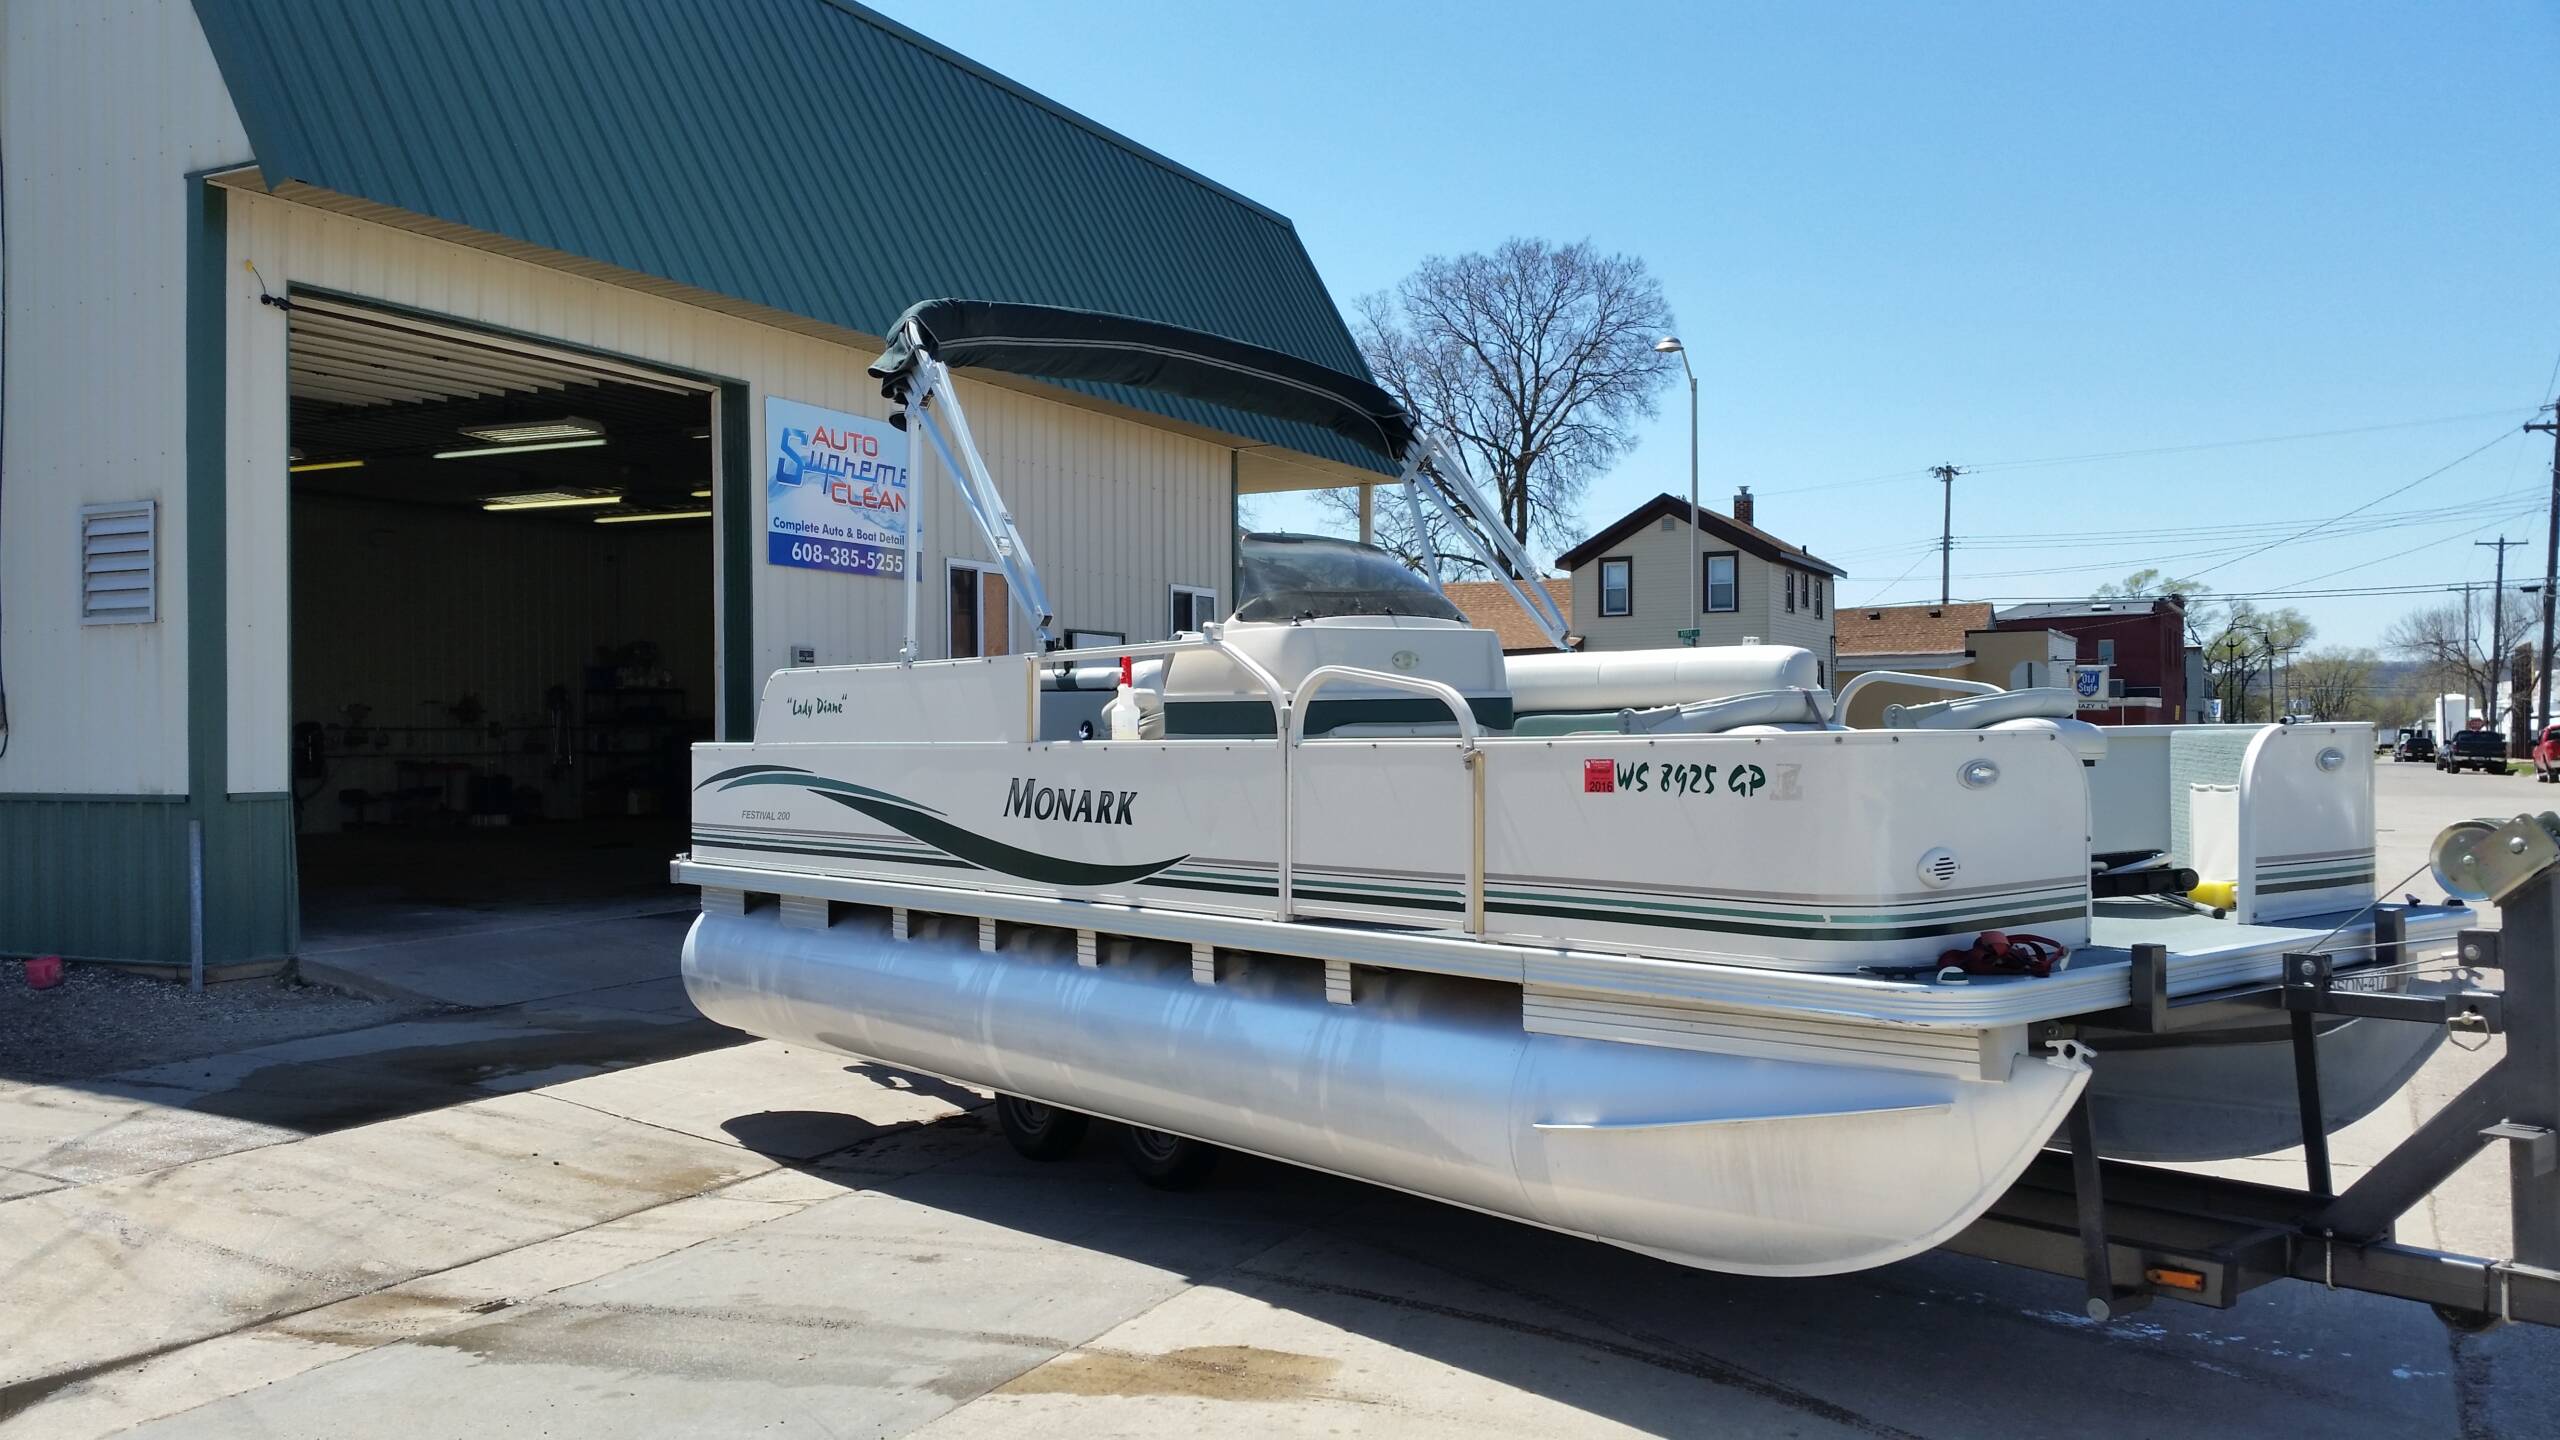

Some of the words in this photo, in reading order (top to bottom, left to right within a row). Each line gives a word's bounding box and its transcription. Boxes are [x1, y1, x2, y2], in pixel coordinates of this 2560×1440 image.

[812, 425, 878, 457] AUTO
[831, 482, 906, 513] CLEAN
[773, 516, 820, 534] Complete
[822, 524, 844, 537] Auto
[846, 526, 854, 539] &
[856, 528, 877, 542] Boat
[791, 542, 904, 573] 608-385-5255
[2078, 683, 2098, 696] Style
[2082, 674, 2096, 684] Old
[1589, 780, 1614, 793] 2016
[1616, 761, 1650, 792] WS
[1660, 763, 1717, 798] 8925
[1727, 763, 1767, 798] GP
[741, 810, 776, 821] FESTIVAL
[777, 811, 791, 821] 200
[1002, 777, 1138, 826] MONARK
